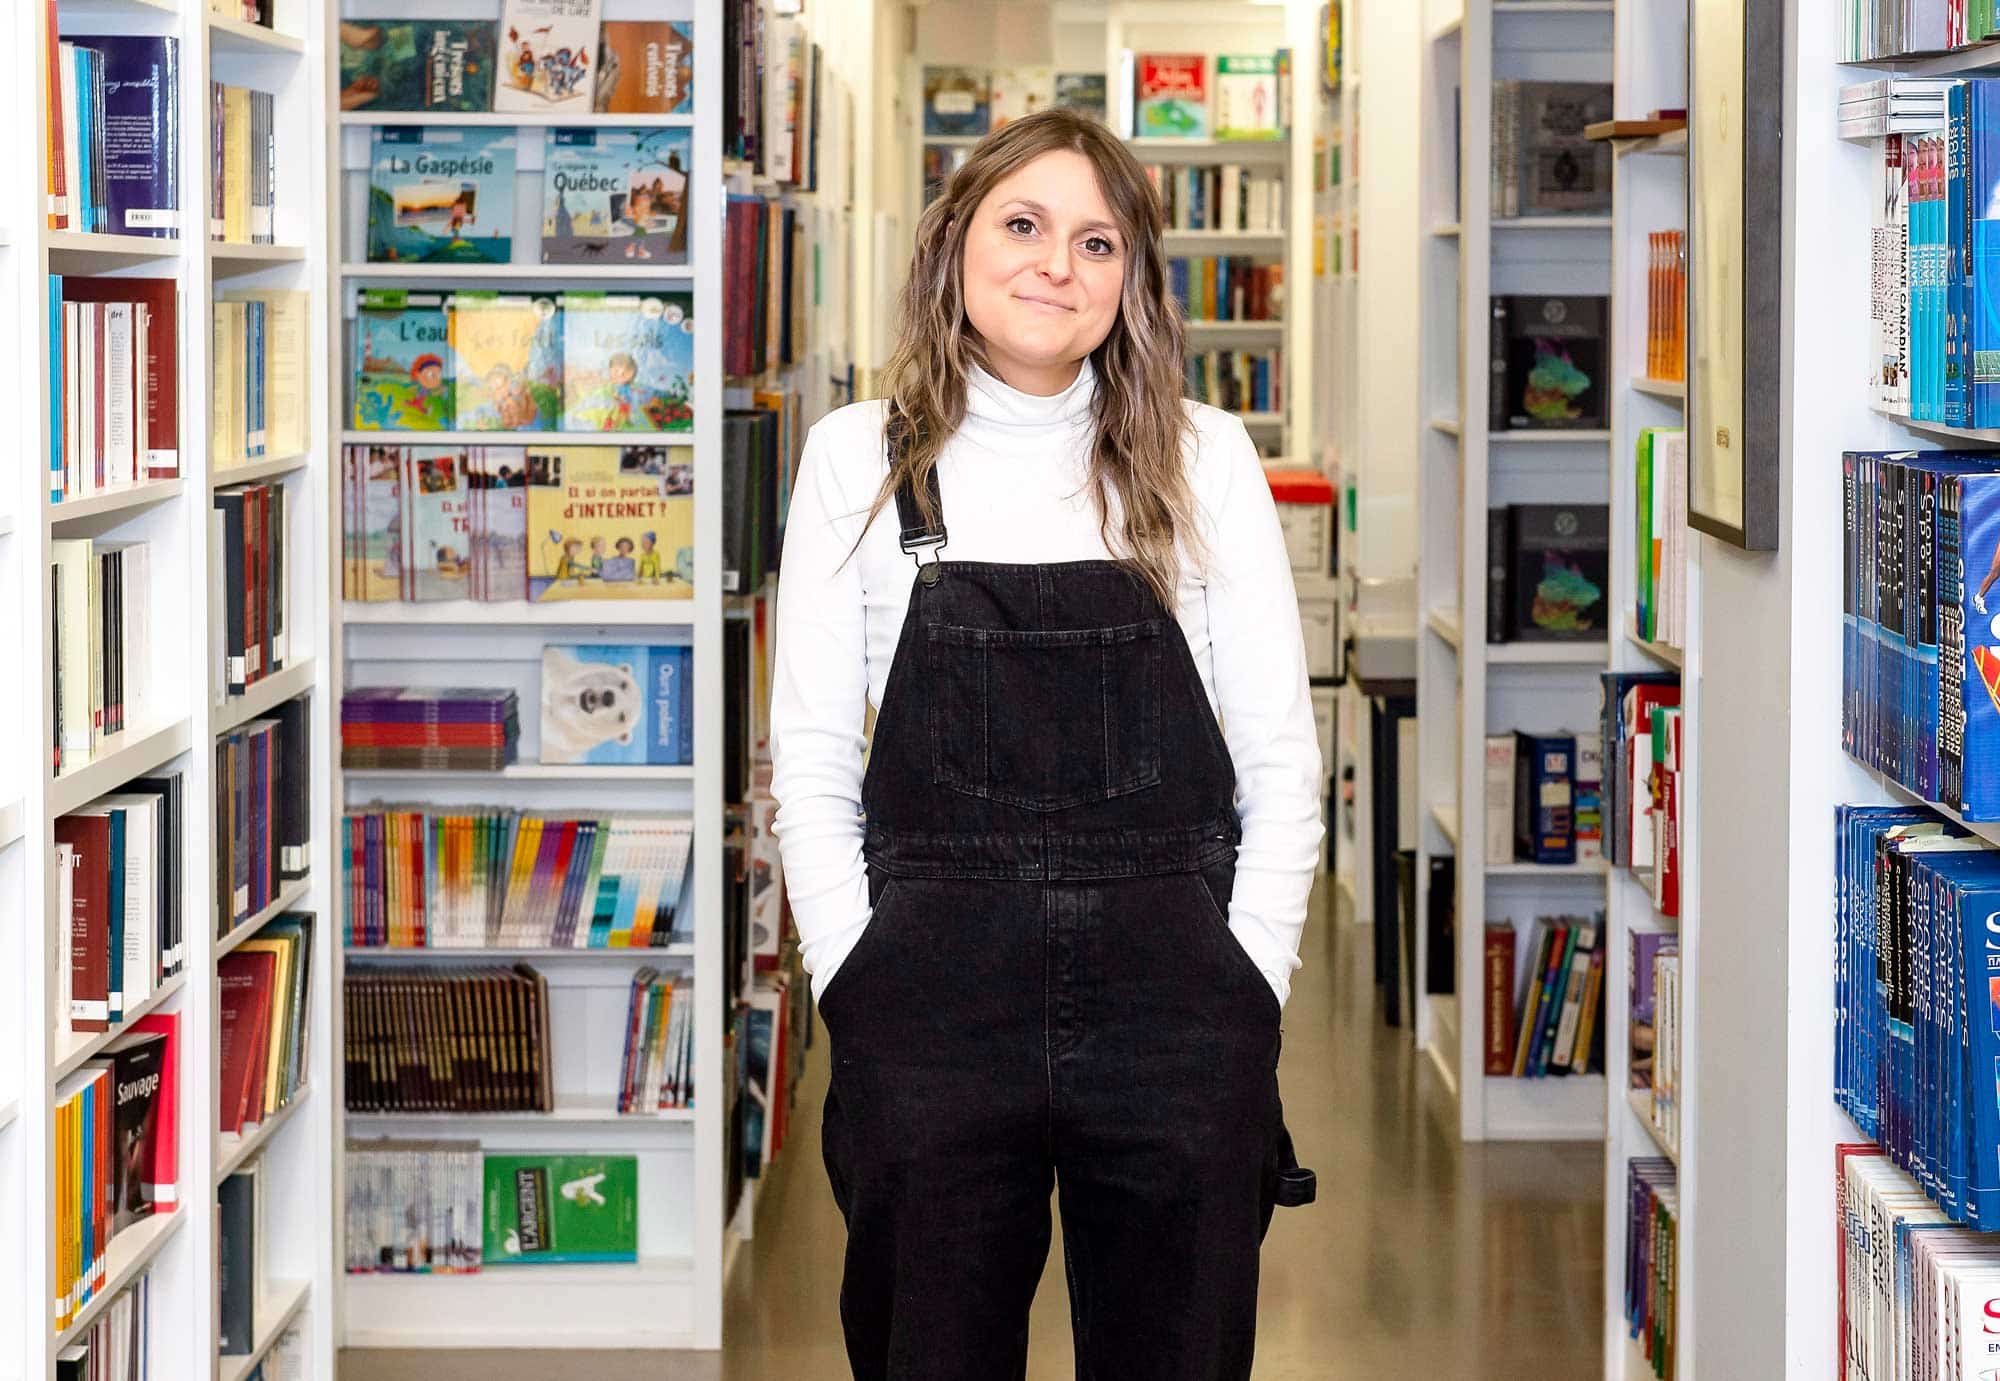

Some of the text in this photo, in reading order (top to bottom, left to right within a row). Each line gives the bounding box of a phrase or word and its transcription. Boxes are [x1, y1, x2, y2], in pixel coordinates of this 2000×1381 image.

[390, 154, 494, 178] La Gaspésie
[554, 172, 619, 193] Québec
[401, 321, 448, 343] L'eau
[1899, 293, 1907, 372] CANADIAN
[563, 501, 667, 519] d'INTERNET ?
[1897, 489, 1905, 610] Sports
[1939, 886, 1947, 1029] SPORTS
[117, 1072, 159, 1106] Sauvage
